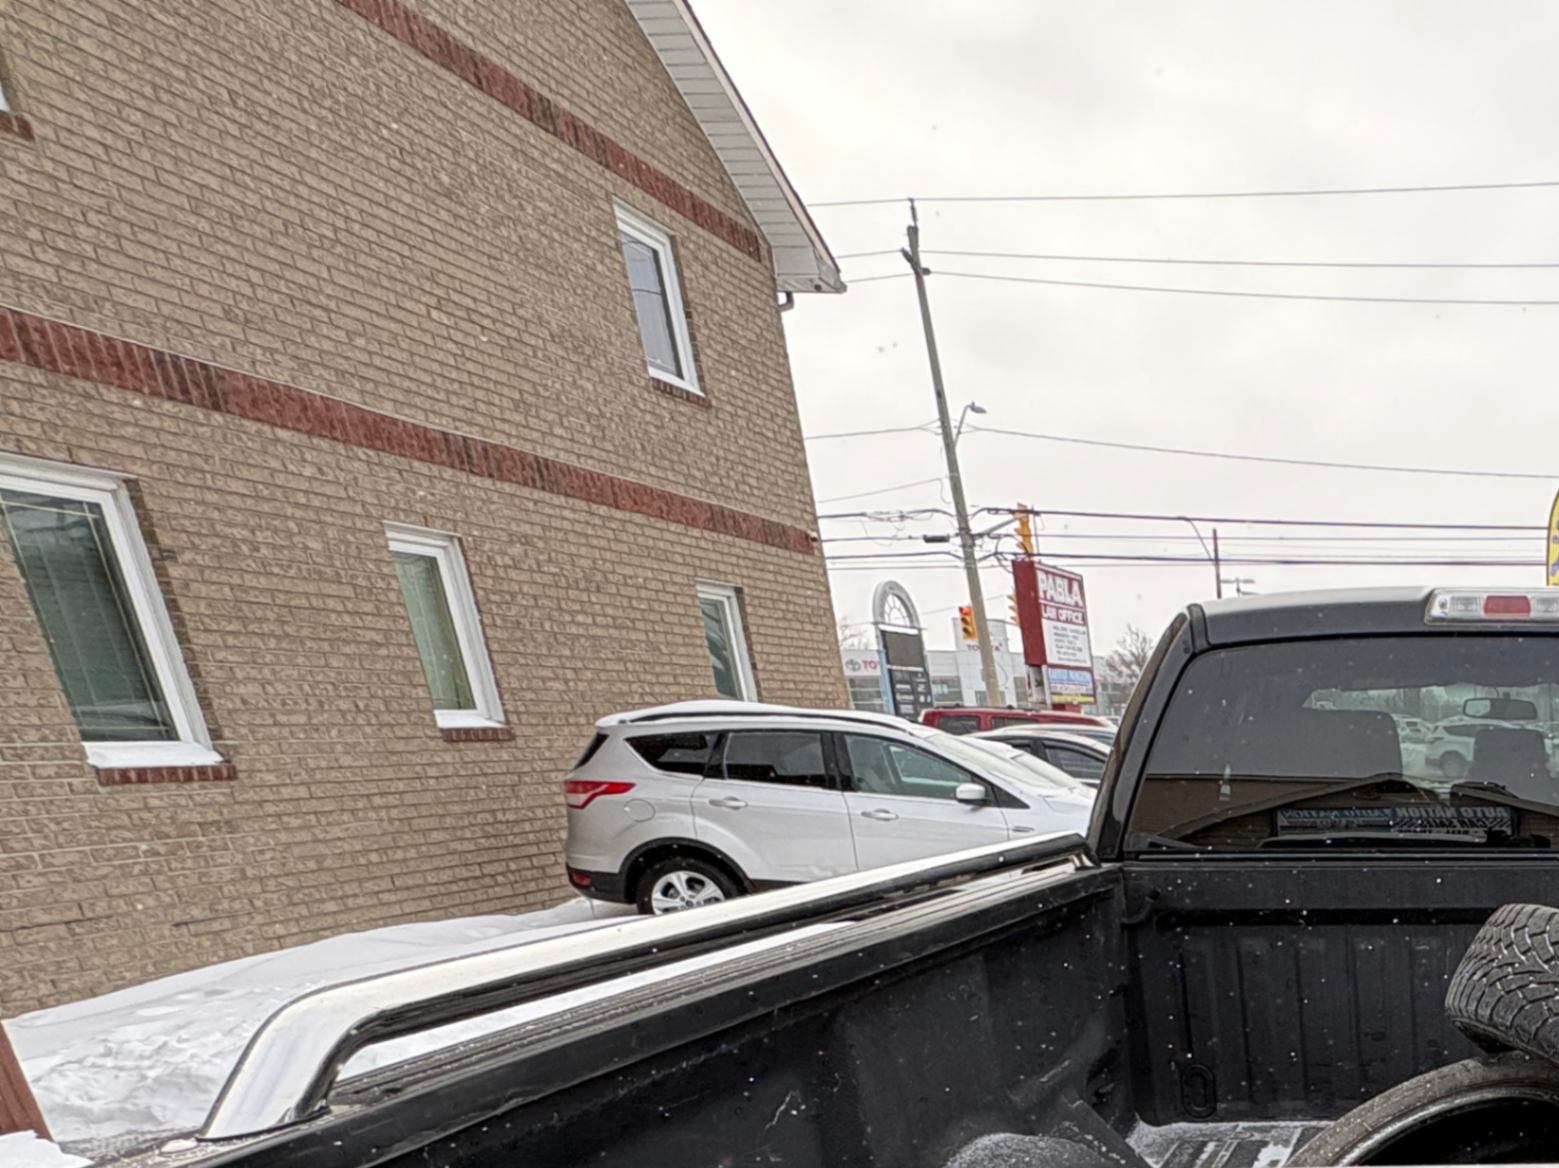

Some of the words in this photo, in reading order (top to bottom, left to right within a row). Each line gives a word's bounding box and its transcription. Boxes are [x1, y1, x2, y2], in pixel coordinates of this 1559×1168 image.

[1037, 569, 1084, 607] PABLA
[1057, 608, 1084, 625] OFFICE
[861, 659, 880, 671] TO
